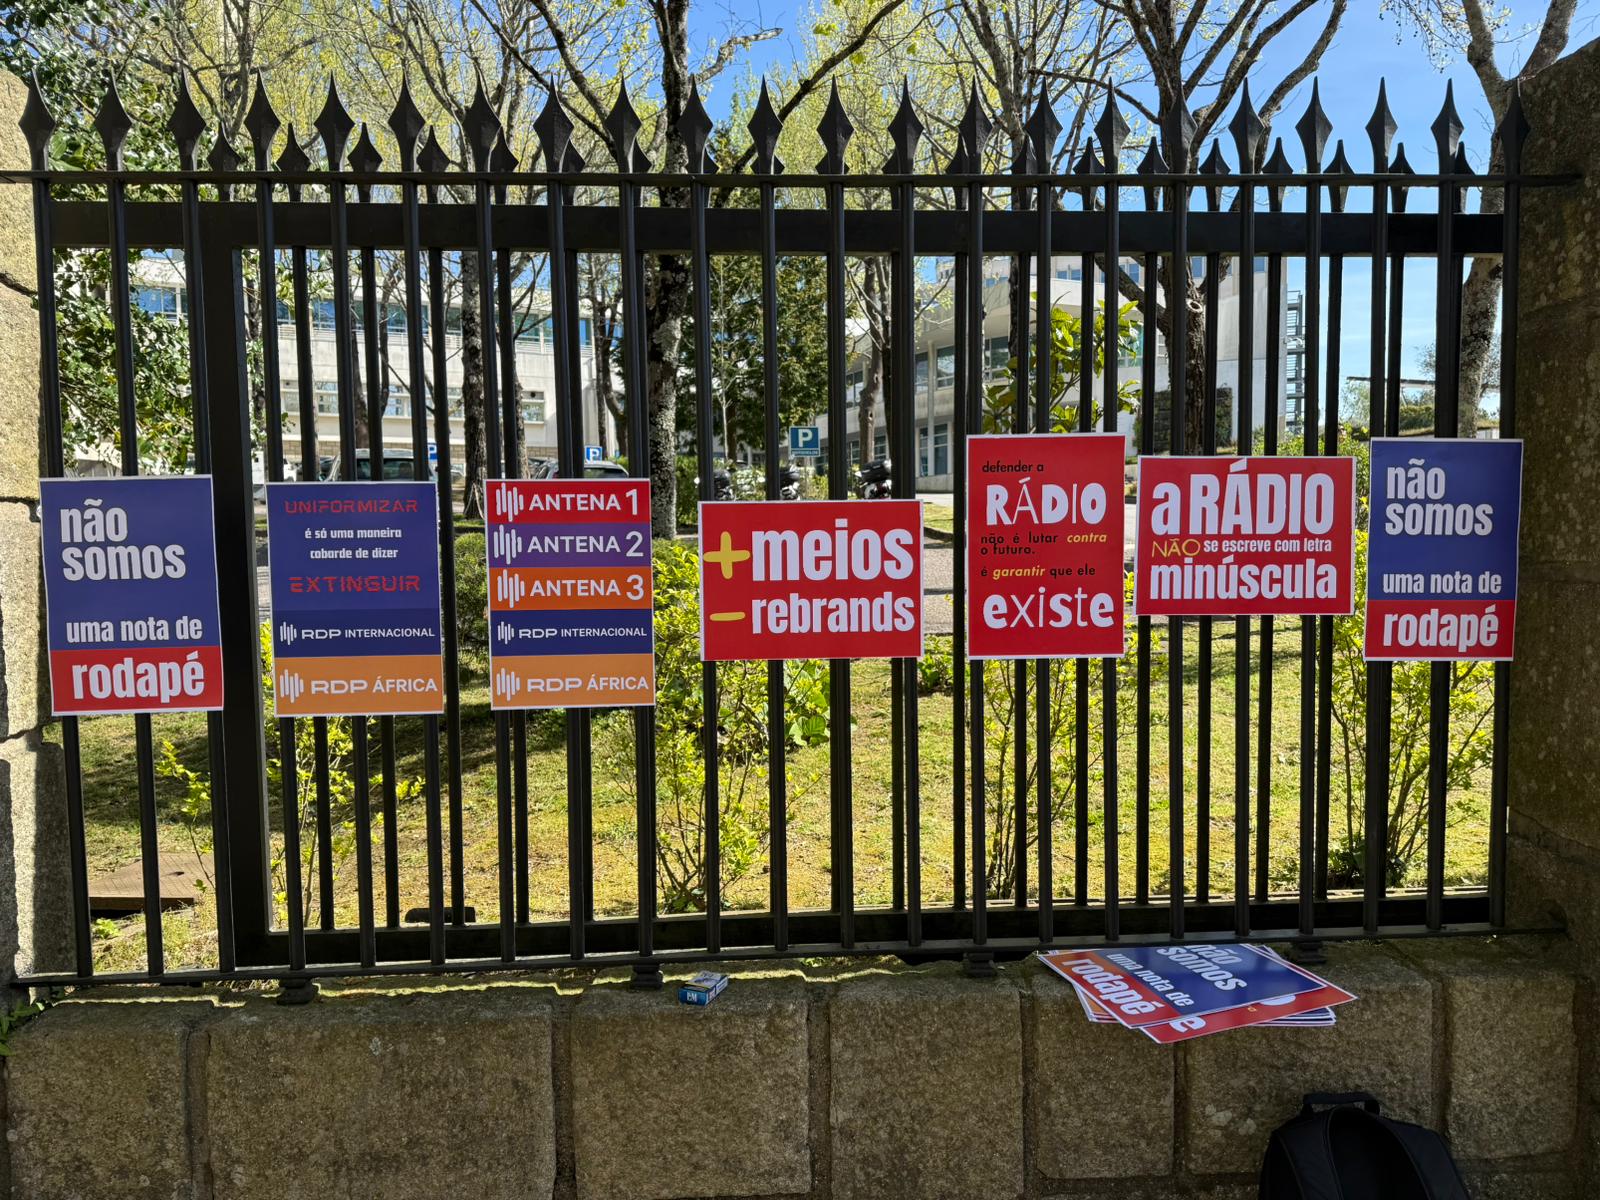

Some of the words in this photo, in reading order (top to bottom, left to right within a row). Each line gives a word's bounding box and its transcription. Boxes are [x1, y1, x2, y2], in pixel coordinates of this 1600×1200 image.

[798, 429, 813, 447] P
[982, 460, 1033, 473] defender
[1036, 463, 1044, 472] a
[1386, 458, 1446, 500] não
[284, 500, 418, 513] UNIFORMIZAR
[529, 494, 622, 512] ANTENA
[625, 489, 640, 515] 1
[986, 476, 1107, 526] RÁDIO
[1151, 481, 1181, 536] a
[1189, 457, 1335, 536] RÁDIO
[60, 498, 128, 543] não
[1385, 503, 1493, 536] somos
[305, 528, 312, 539] é
[315, 527, 327, 539] só
[330, 529, 354, 539] uma
[357, 527, 402, 539] maneira
[527, 535, 621, 553] ANTENA
[625, 531, 645, 557] 2
[981, 533, 1004, 544] não
[1013, 533, 1020, 544] é
[1028, 531, 1058, 544] lutar
[1067, 532, 1107, 543] contra
[310, 548, 352, 559] cobarde
[356, 548, 369, 559] de
[372, 547, 399, 559] dizer
[751, 518, 914, 582] meios
[980, 547, 988, 555] o
[993, 543, 1035, 555] futuro.
[1151, 538, 1201, 558] NÃO
[1203, 540, 1219, 553] se
[1222, 540, 1271, 553] escreve
[1274, 540, 1301, 553] com
[1303, 537, 1332, 553] letra
[62, 544, 186, 582] somos
[981, 566, 988, 577] é
[992, 565, 1045, 580] garantir
[1050, 567, 1072, 579] que
[1077, 563, 1095, 576] ele
[288, 575, 421, 593] EXTINGUIR
[530, 579, 621, 597] ANTENA
[625, 574, 645, 601] 3
[1149, 554, 1337, 600] minúscula
[1382, 573, 1424, 594] uma
[1430, 571, 1472, 594] nota
[1478, 571, 1502, 594] de
[751, 591, 915, 635] rebrands
[983, 586, 1114, 629] existe
[66, 620, 114, 643] uma
[121, 617, 169, 642] nota
[176, 615, 202, 639] de
[301, 629, 342, 639] RDP
[344, 628, 436, 638] INTERNACIONAL
[518, 628, 558, 639] RDP
[560, 627, 648, 637] INTERNACIONAL
[1383, 604, 1499, 652] rodapé
[72, 651, 205, 703] rodapé
[311, 680, 368, 695] RDP
[372, 676, 438, 693] ÁFRICA
[527, 677, 582, 692] RDP
[586, 674, 649, 691] ÁFRICA
[1106, 953, 1144, 971] uma
[1135, 969, 1175, 992] nota
[1165, 992, 1195, 1007] de
[1156, 946, 1248, 991] somos
[1062, 959, 1165, 1015] rodapé
